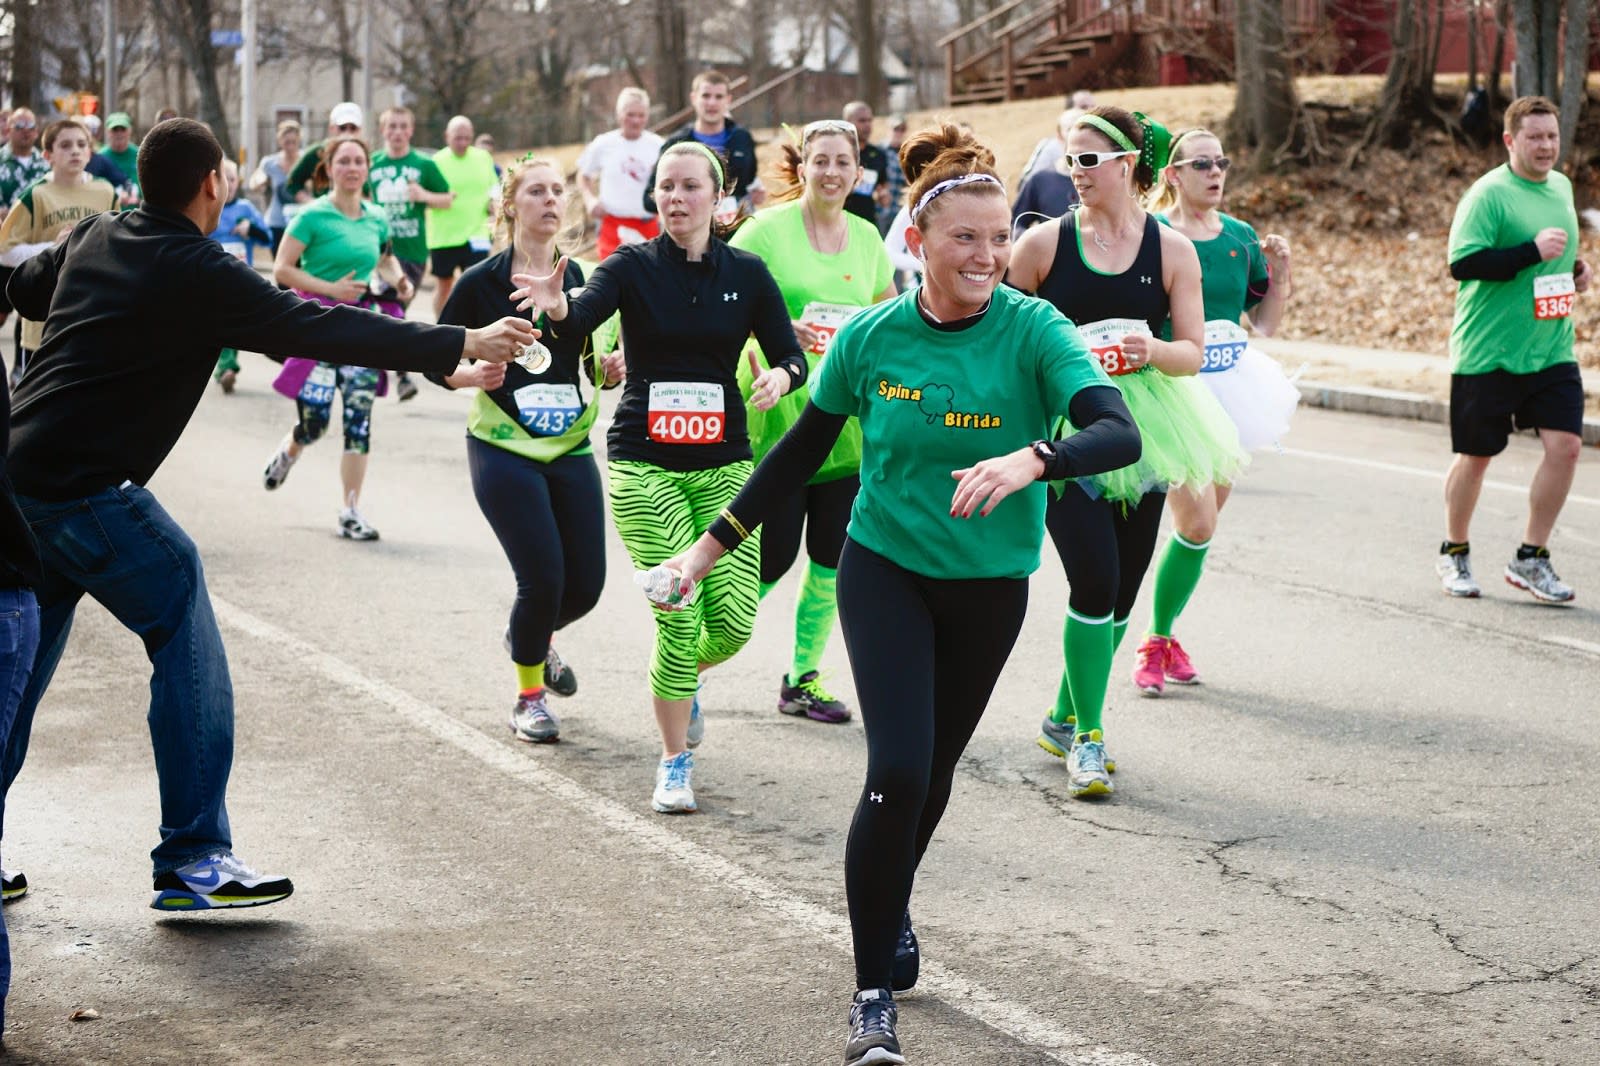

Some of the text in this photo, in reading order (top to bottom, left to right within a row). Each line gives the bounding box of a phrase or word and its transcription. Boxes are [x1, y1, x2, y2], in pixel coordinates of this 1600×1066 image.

[43, 206, 81, 228] HUNGRY
[878, 380, 921, 401] Spina
[651, 415, 721, 440] 4009
[944, 411, 1001, 428] Bifida
